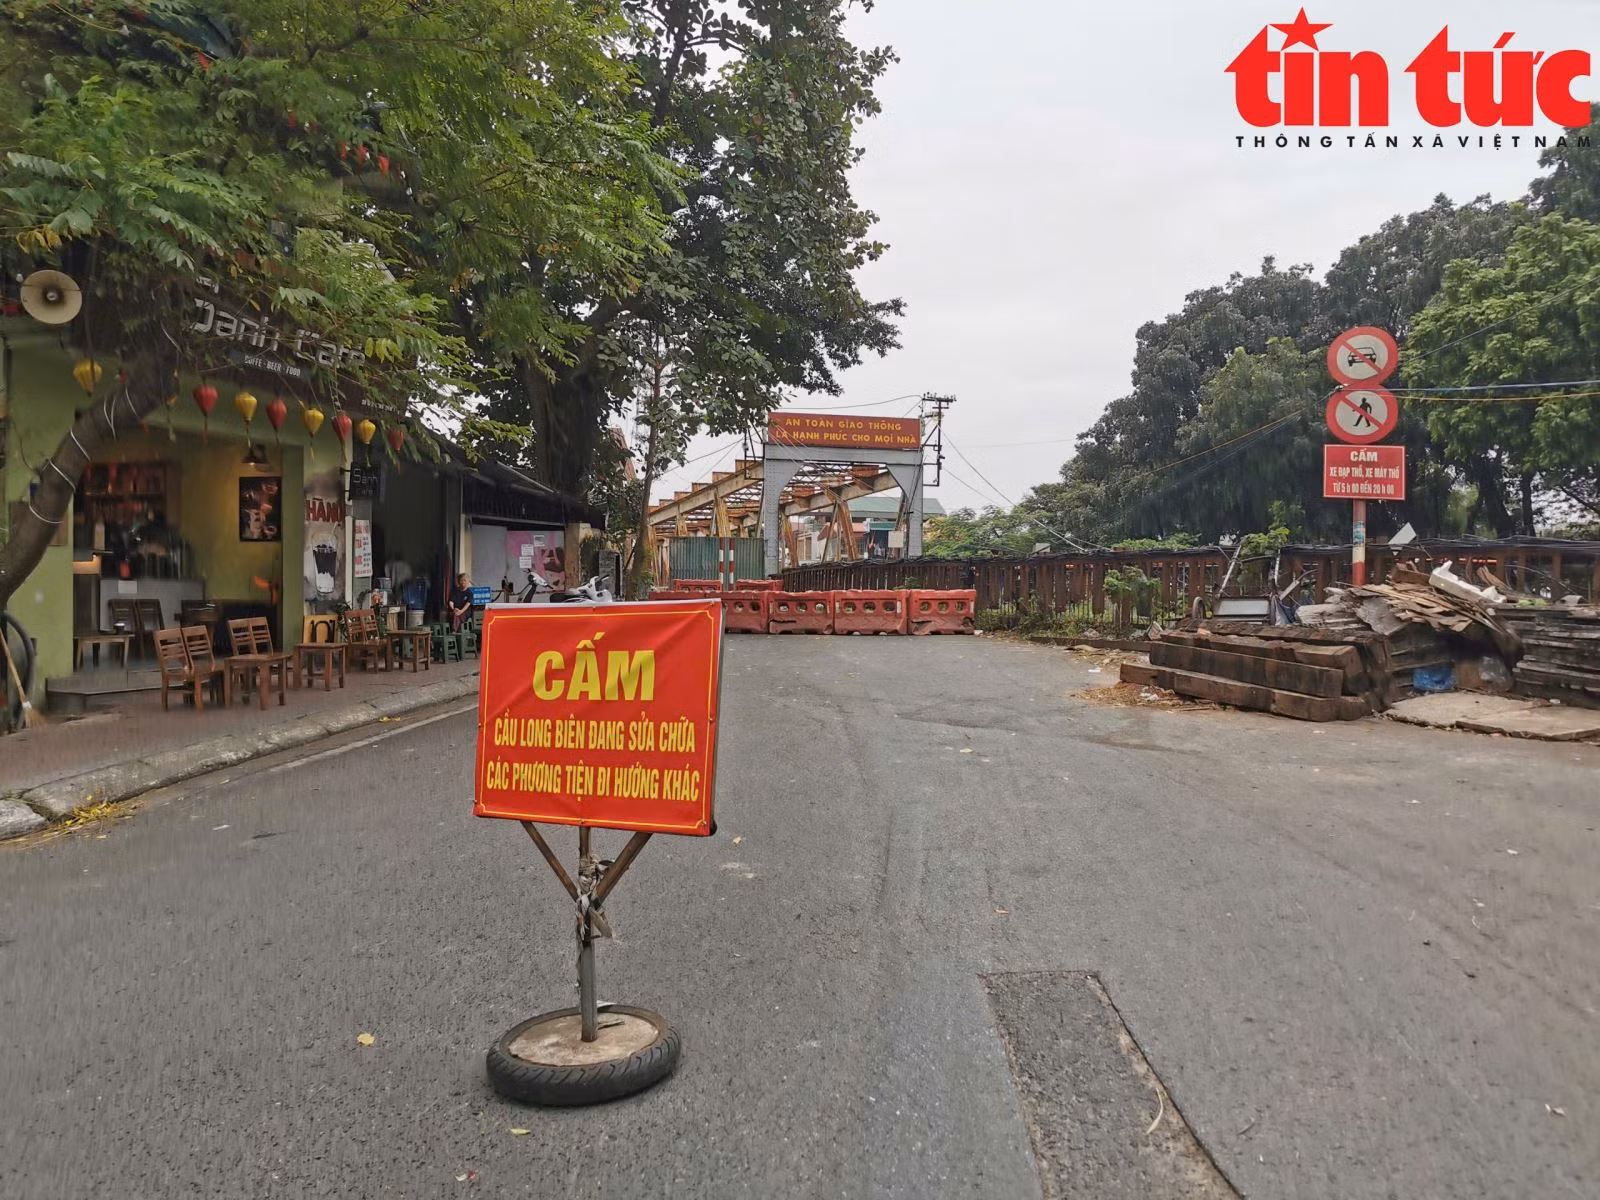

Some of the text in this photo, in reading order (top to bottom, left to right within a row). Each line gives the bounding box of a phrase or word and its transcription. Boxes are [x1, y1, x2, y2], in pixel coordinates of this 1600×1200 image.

[266, 360, 282, 372] BEER
[286, 365, 301, 377] FOOD
[785, 418, 800, 426] AN
[805, 418, 833, 428] TOÀN
[869, 420, 901, 431] THÔNG
[793, 432, 820, 442] HẠNH
[824, 430, 848, 441] PHÚC
[852, 433, 870, 442] CHO
[897, 434, 916, 444] NHÀ
[1350, 448, 1378, 462] CẤM
[1330, 467, 1337, 477] XE
[1365, 467, 1373, 477] XE
[1374, 466, 1387, 478] MÁY
[532, 632, 655, 701] CẤM
[494, 708, 696, 753] CẦU LONG BIÊN ĐANG SỬA CHỮA
[486, 755, 700, 802] CÁC PHƯƠNG TIỆN ĐI HƯỚNG KHÁC
